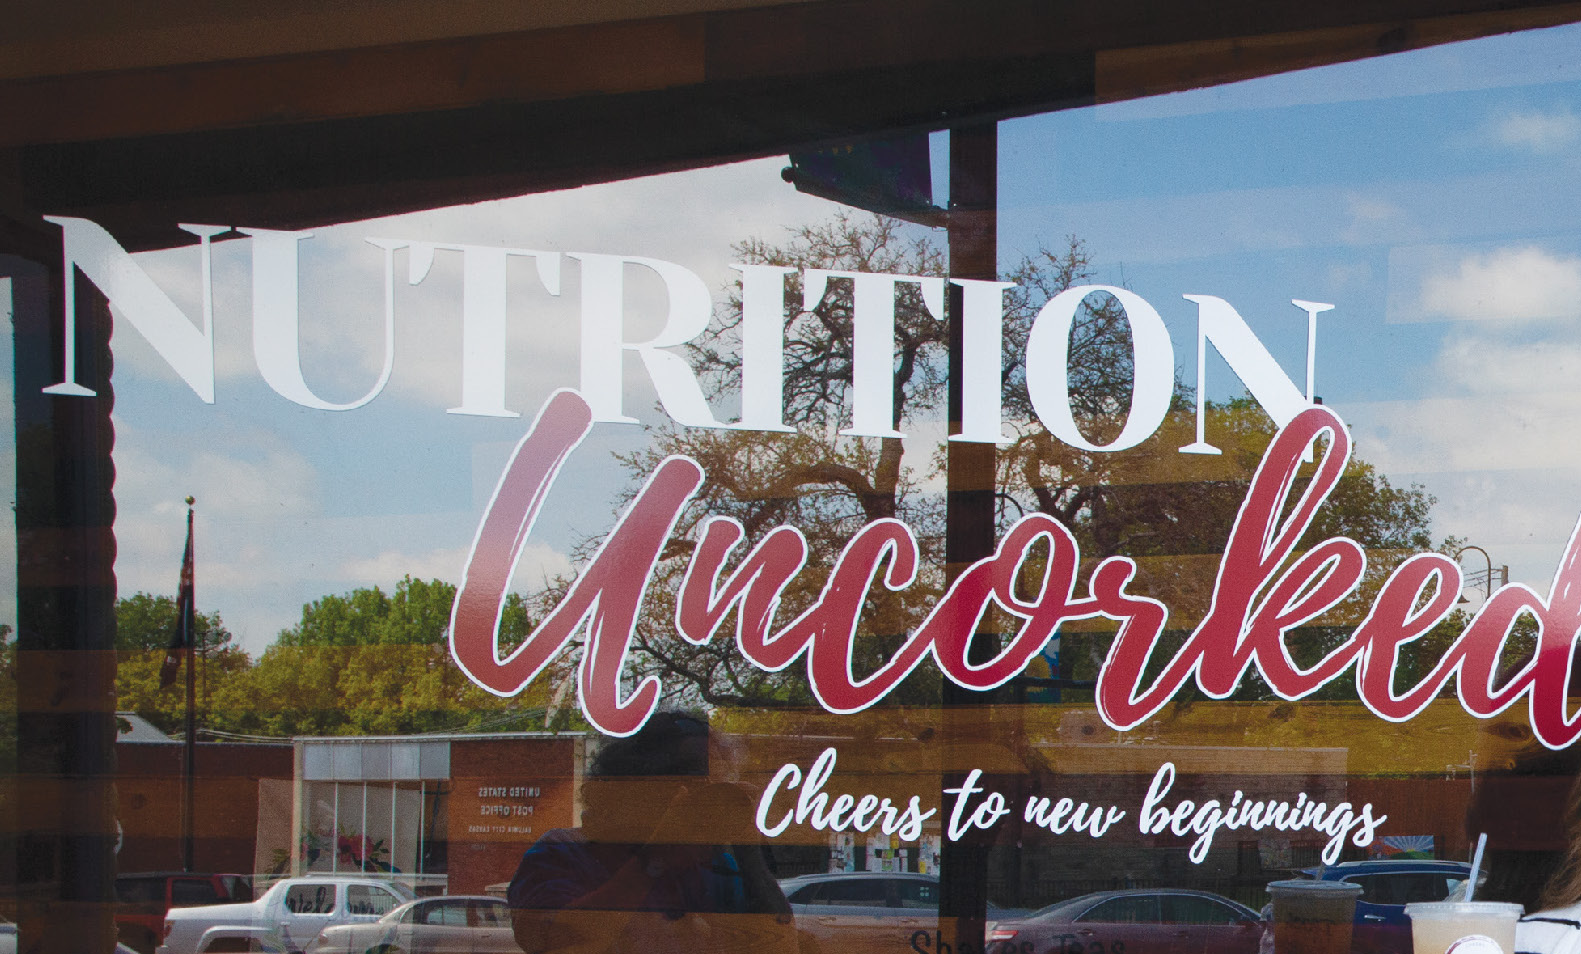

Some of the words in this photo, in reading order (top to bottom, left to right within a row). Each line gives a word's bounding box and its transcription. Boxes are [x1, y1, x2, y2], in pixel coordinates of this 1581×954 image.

[42, 214, 1336, 462] NUTRITION
[756, 747, 937, 842] Cheers
[943, 768, 1011, 842] to
[1024, 796, 1126, 838] new
[1139, 762, 1387, 866] beginnings
